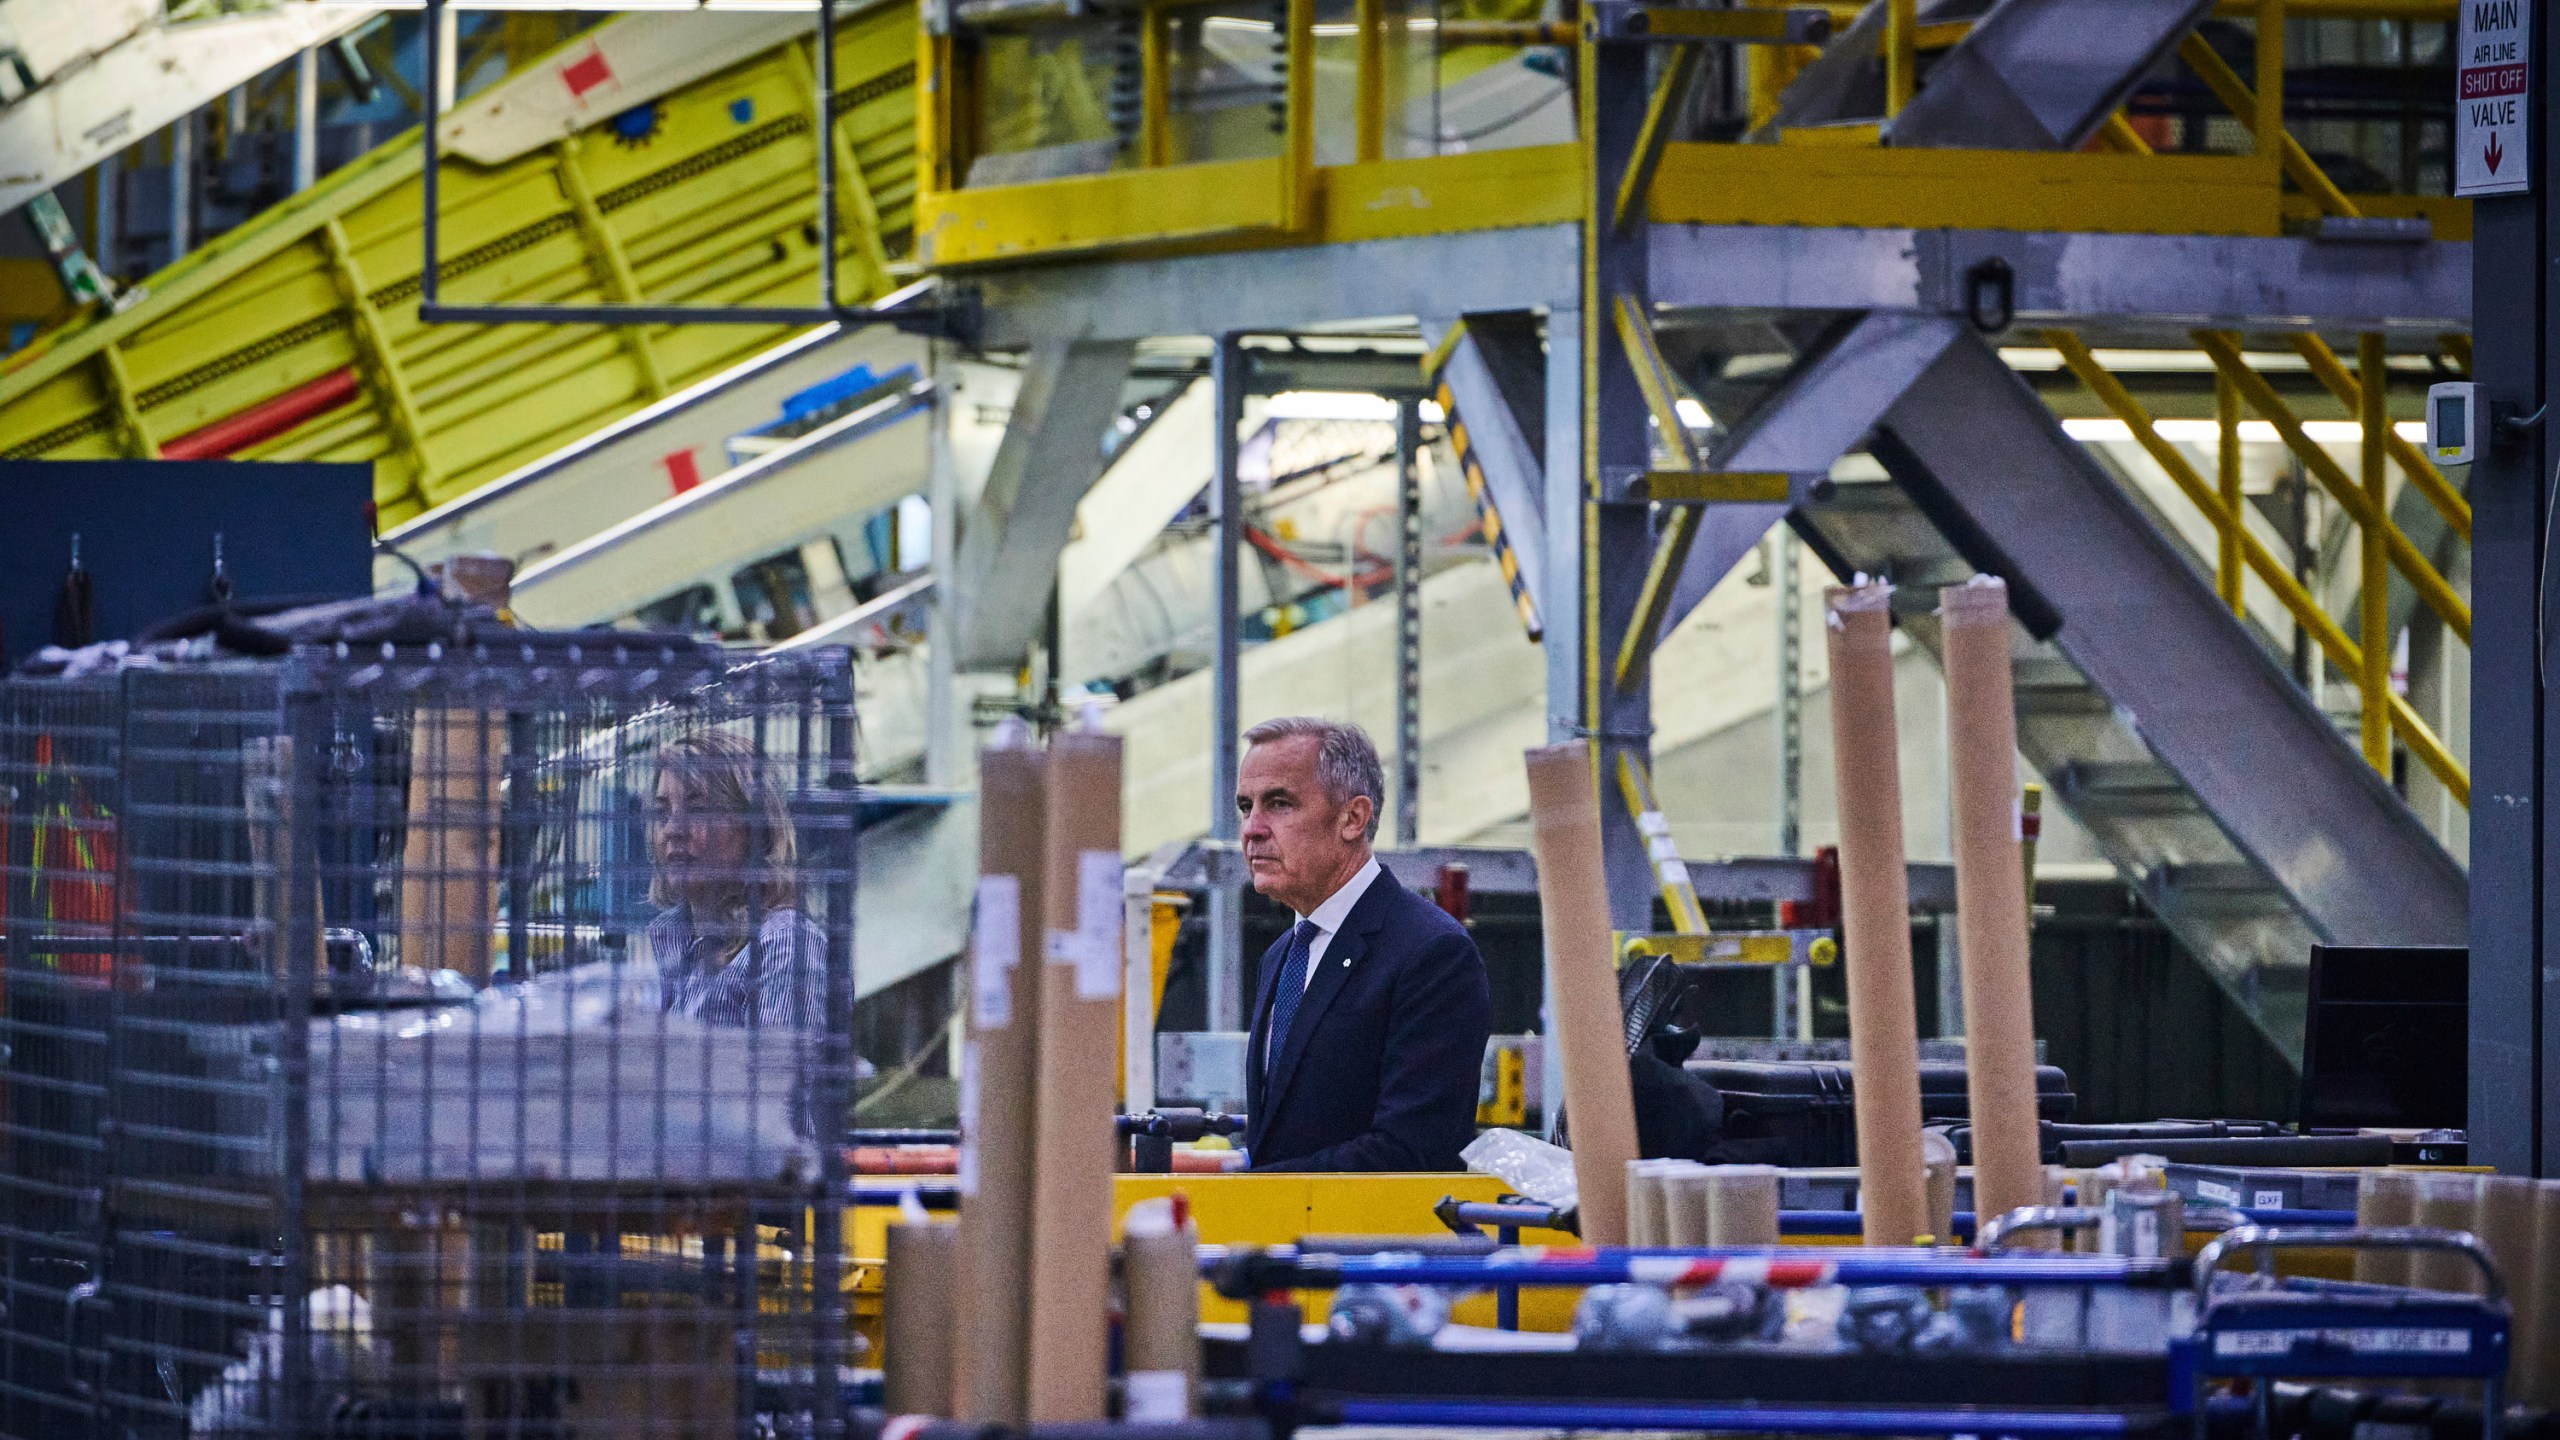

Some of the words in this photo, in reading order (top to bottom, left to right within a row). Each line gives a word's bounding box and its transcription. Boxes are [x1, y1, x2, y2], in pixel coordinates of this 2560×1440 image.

[2474, 1, 2518, 33] MAIN
[2474, 44, 2491, 63] AIR
[2493, 42, 2516, 61] LINE
[2465, 71, 2497, 93] SHUT
[2500, 69, 2523, 90] OFF
[2471, 101, 2516, 127] VALVE
